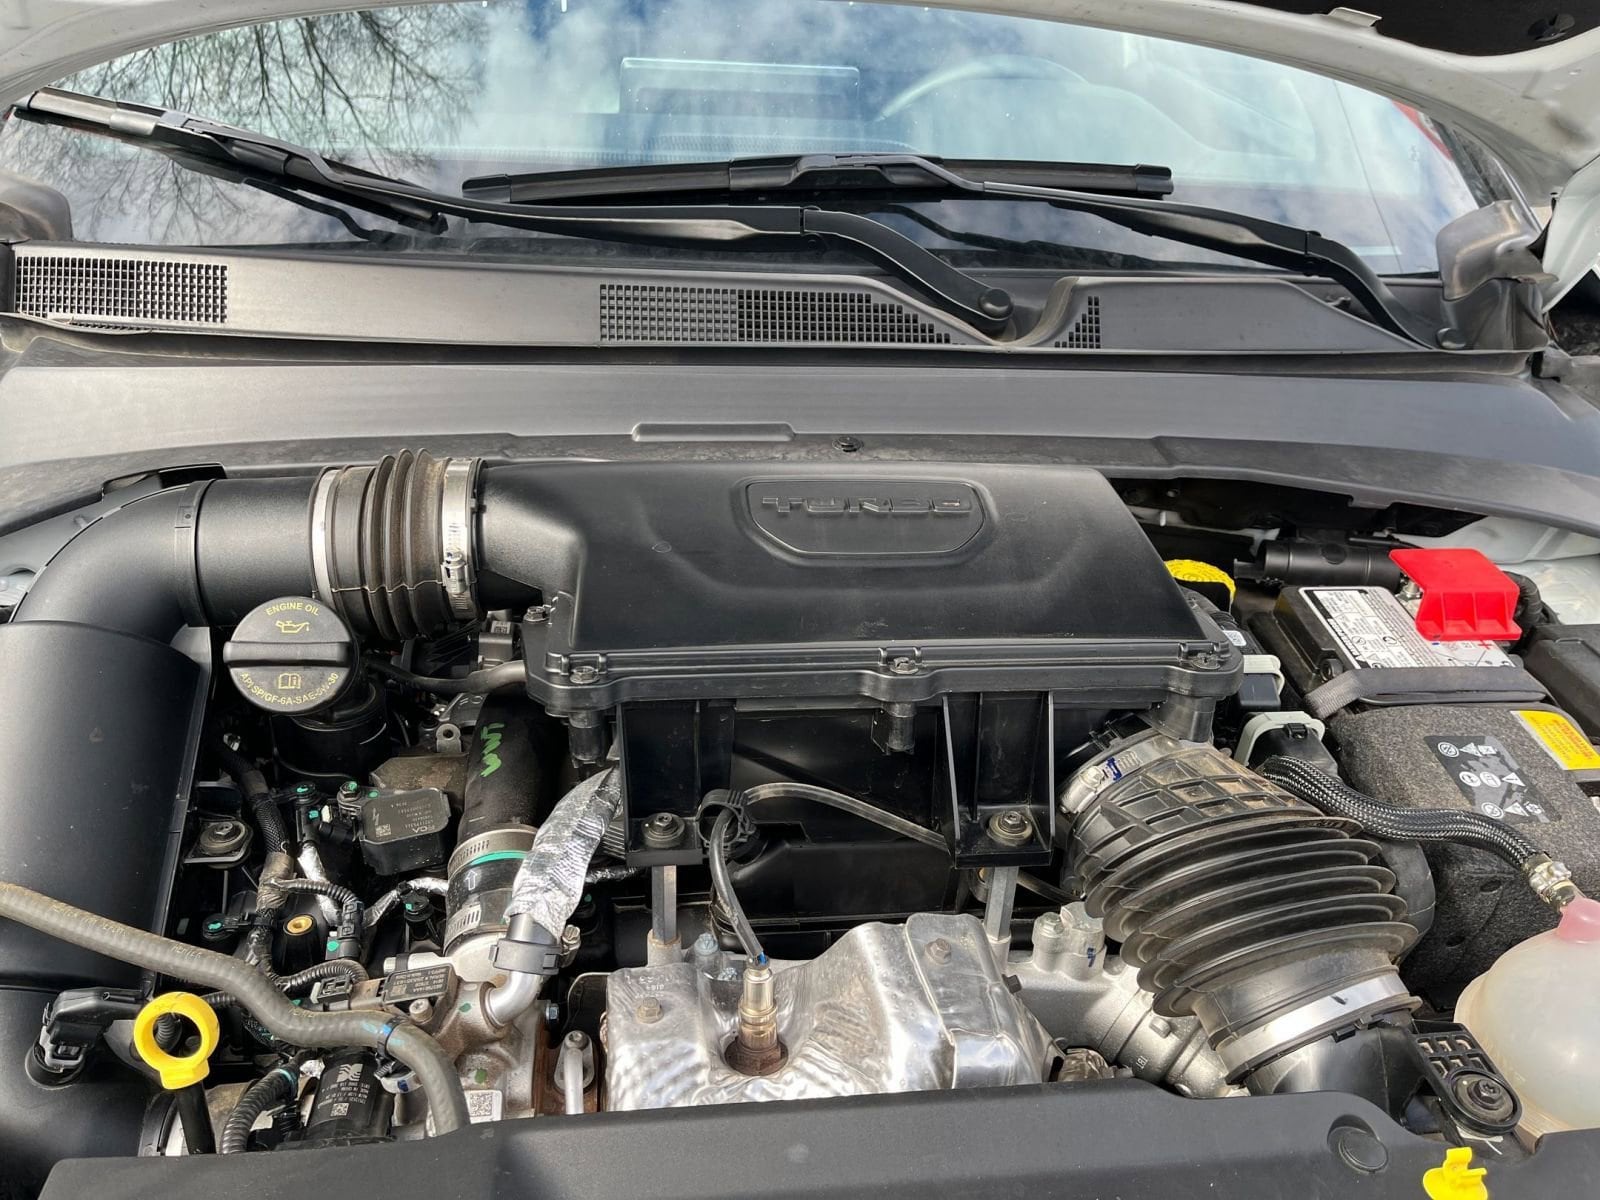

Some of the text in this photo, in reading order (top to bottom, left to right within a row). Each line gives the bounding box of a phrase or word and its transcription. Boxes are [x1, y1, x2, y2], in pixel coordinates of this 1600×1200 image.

[761, 497, 972, 514] TURBO
[265, 602, 320, 616] ENGINE OIL
[240, 672, 253, 689] API
